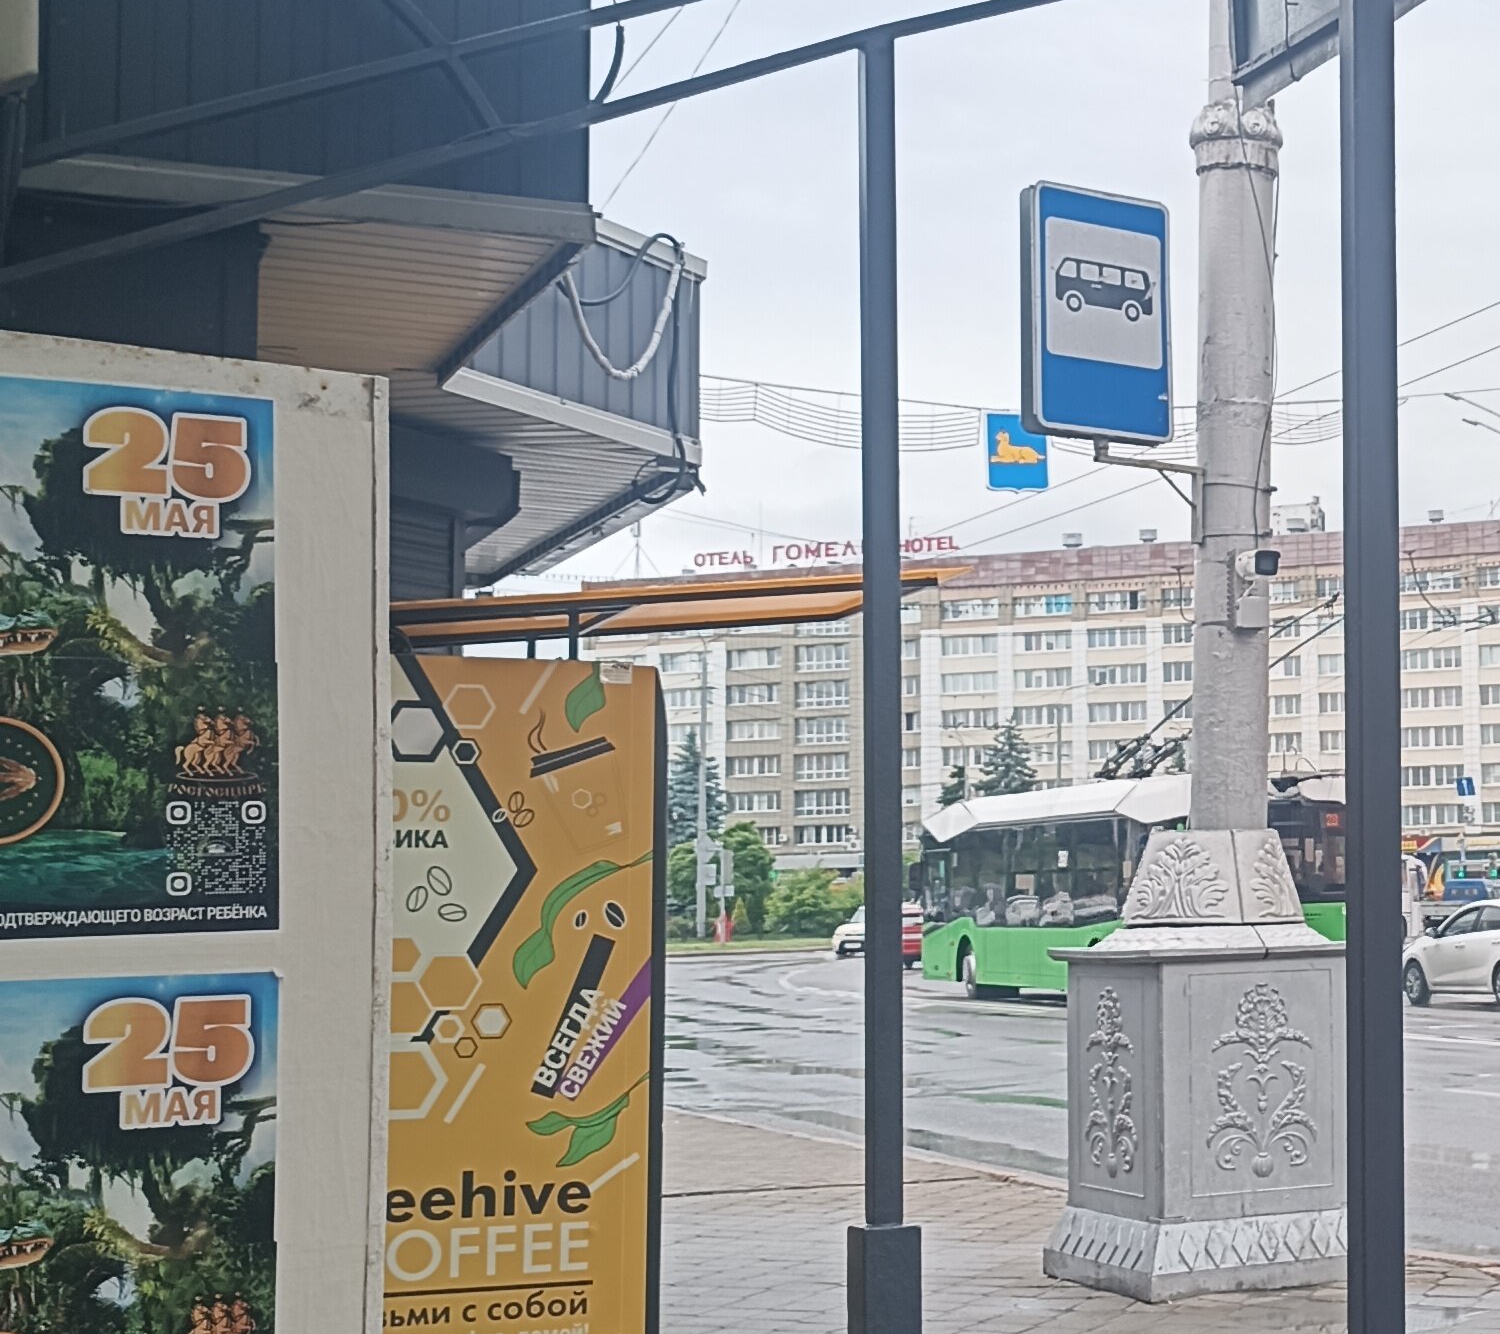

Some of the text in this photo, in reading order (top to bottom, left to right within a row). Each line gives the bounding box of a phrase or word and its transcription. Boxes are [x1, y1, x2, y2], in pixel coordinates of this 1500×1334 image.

[84, 408, 249, 501] 25
[123, 498, 216, 535] МАЯ
[694, 539, 864, 567] ОТЕЛЬ ГОМЕЛ
[392, 829, 449, 849] ИКА
[0, 904, 267, 930] ОДТВЕРЖДАЮЩЕГО ВОЗРАСТ РЕБЁНКА
[82, 994, 254, 1093] 25
[534, 988, 604, 1088] ВСЕГДА
[560, 998, 627, 1099] СВЕЖИЙ
[123, 1088, 219, 1127] МАЯ
[386, 1169, 591, 1222] eehive
[386, 1222, 590, 1282] OFFEE
[462, 1303, 477, 1322] с
[487, 1291, 588, 1321] собой
